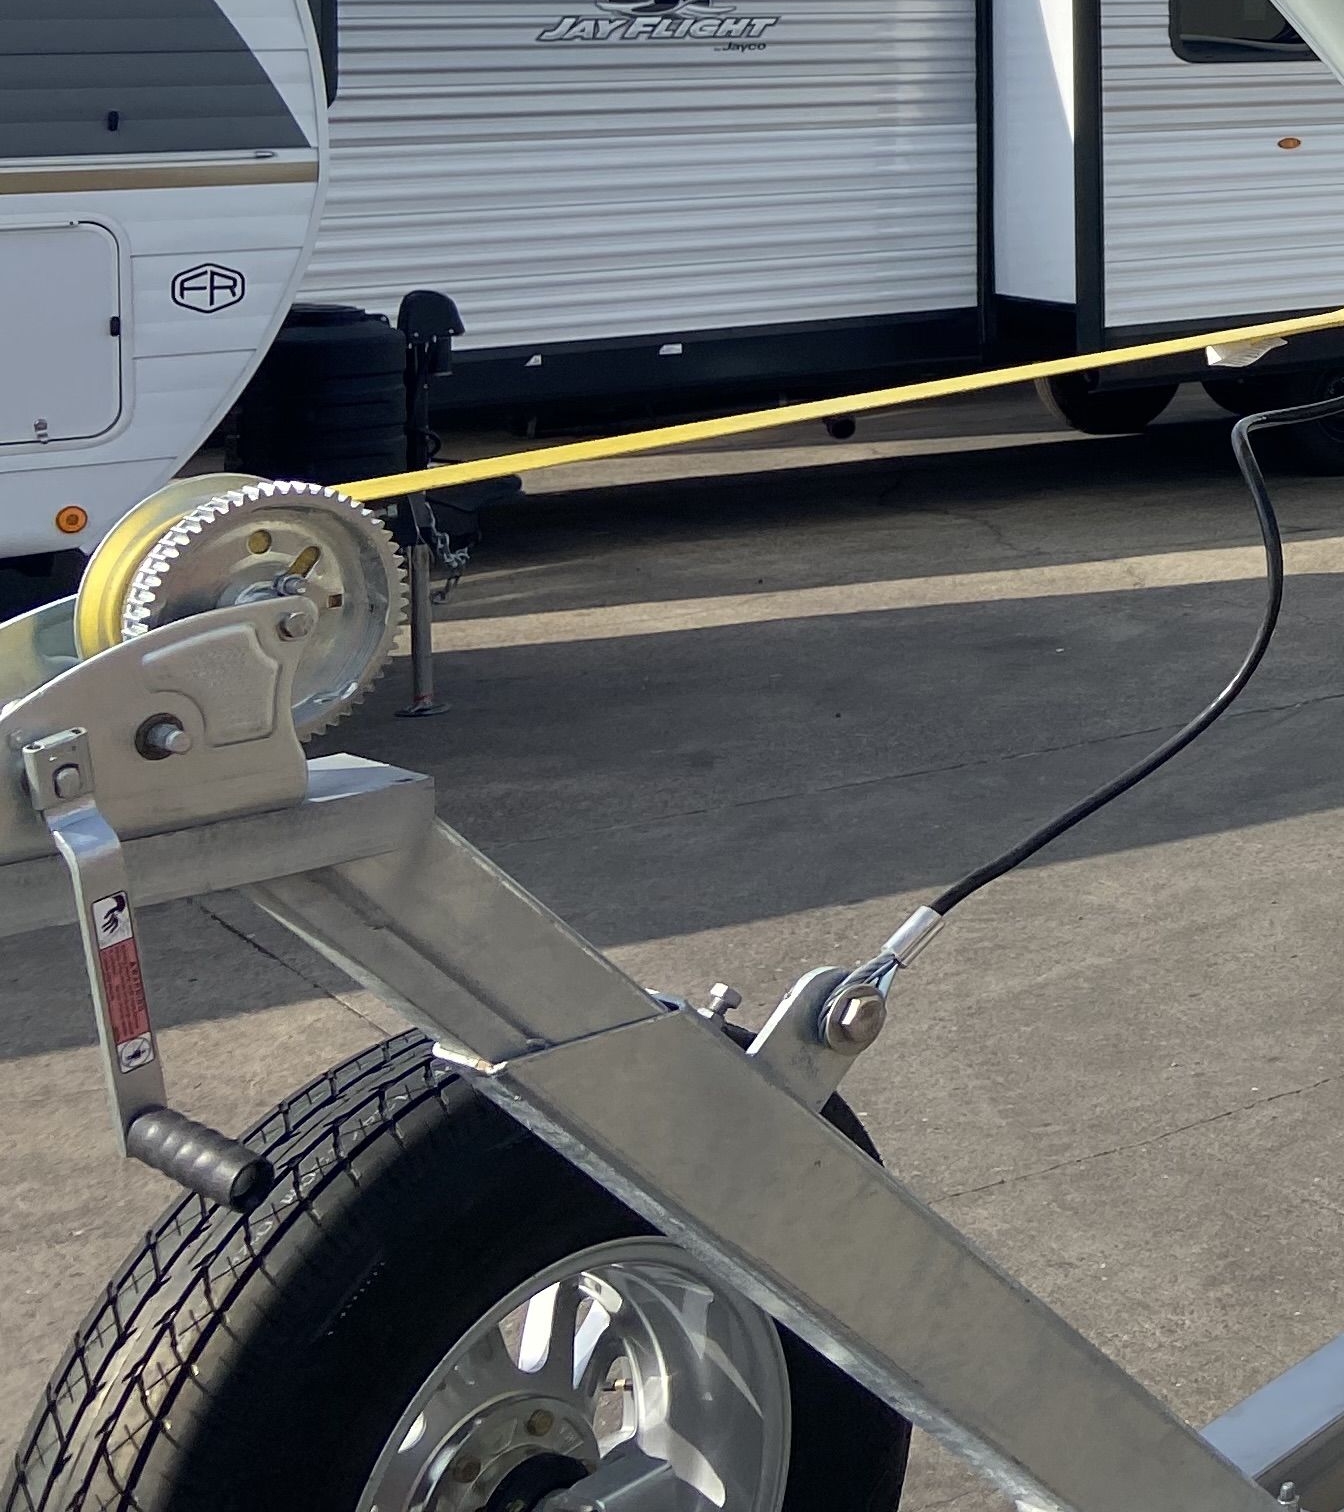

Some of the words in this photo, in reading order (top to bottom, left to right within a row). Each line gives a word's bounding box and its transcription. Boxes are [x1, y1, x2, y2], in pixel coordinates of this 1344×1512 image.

[625, 15, 781, 39] FLIGHT
[722, 41, 766, 52] Jayco
[180, 270, 237, 306] FR
